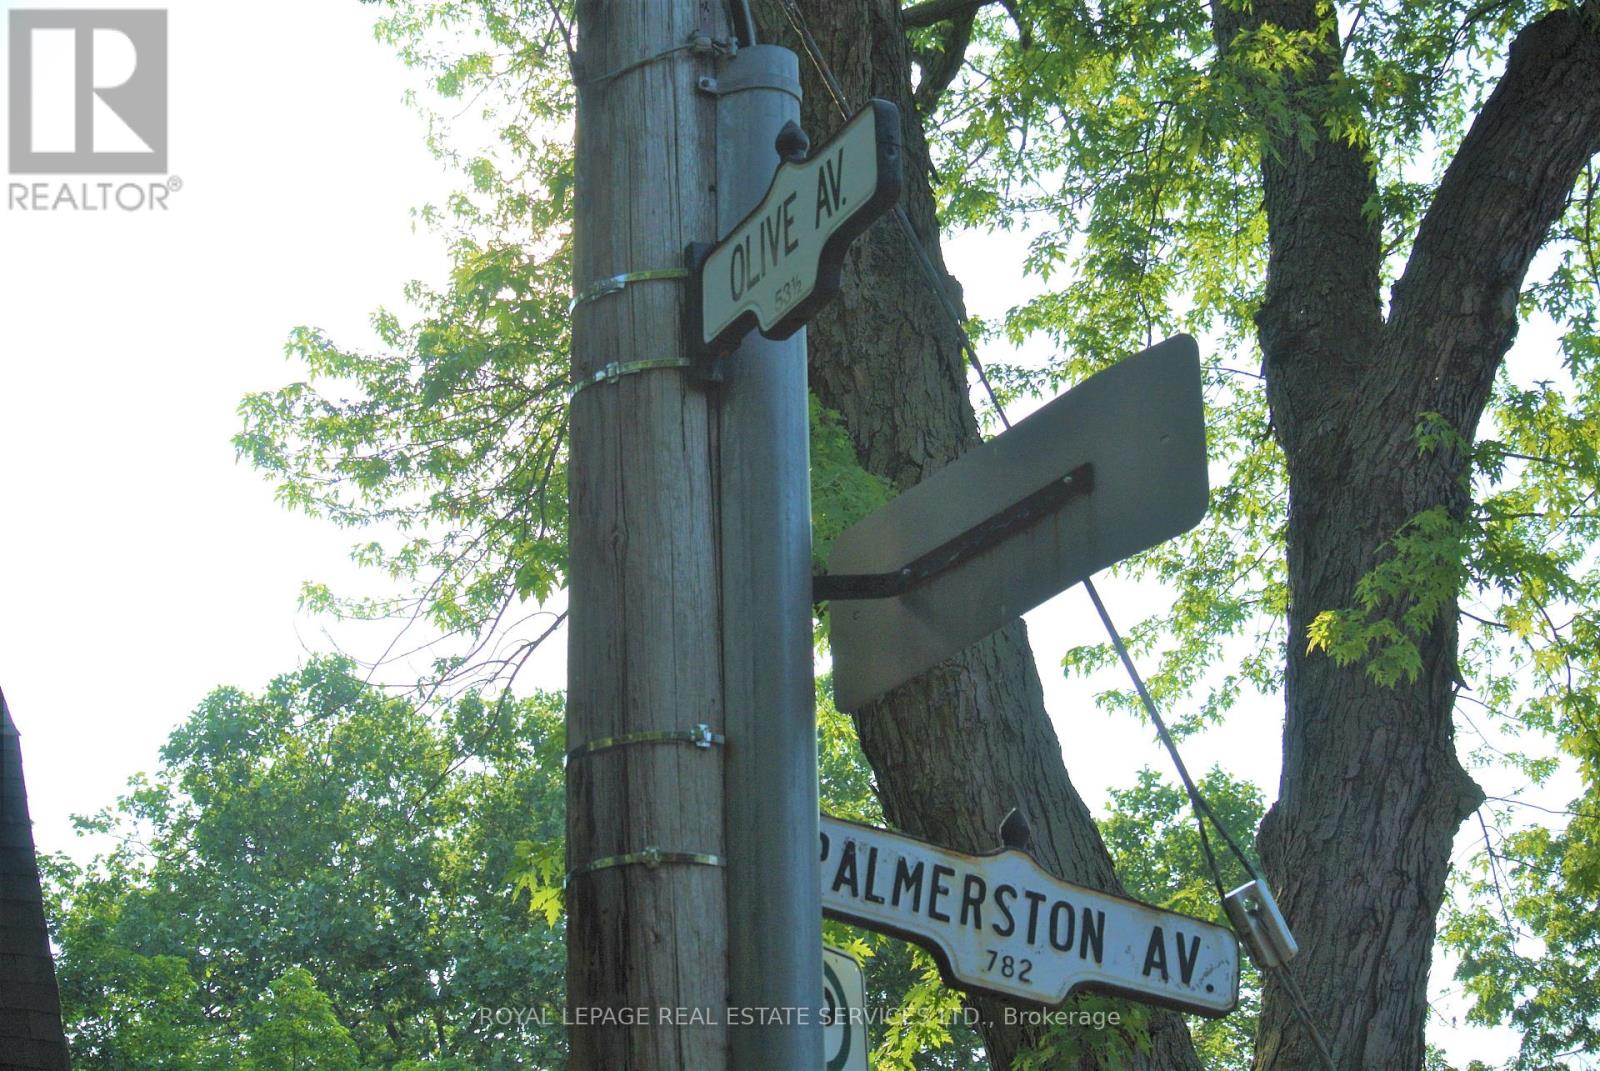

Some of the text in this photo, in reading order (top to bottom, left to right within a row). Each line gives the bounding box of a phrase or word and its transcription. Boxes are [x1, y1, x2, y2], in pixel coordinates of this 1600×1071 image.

[730, 148, 847, 302] OLIVE AV.
[986, 950, 1033, 984] 782
[1142, 926, 1214, 993] AV.
